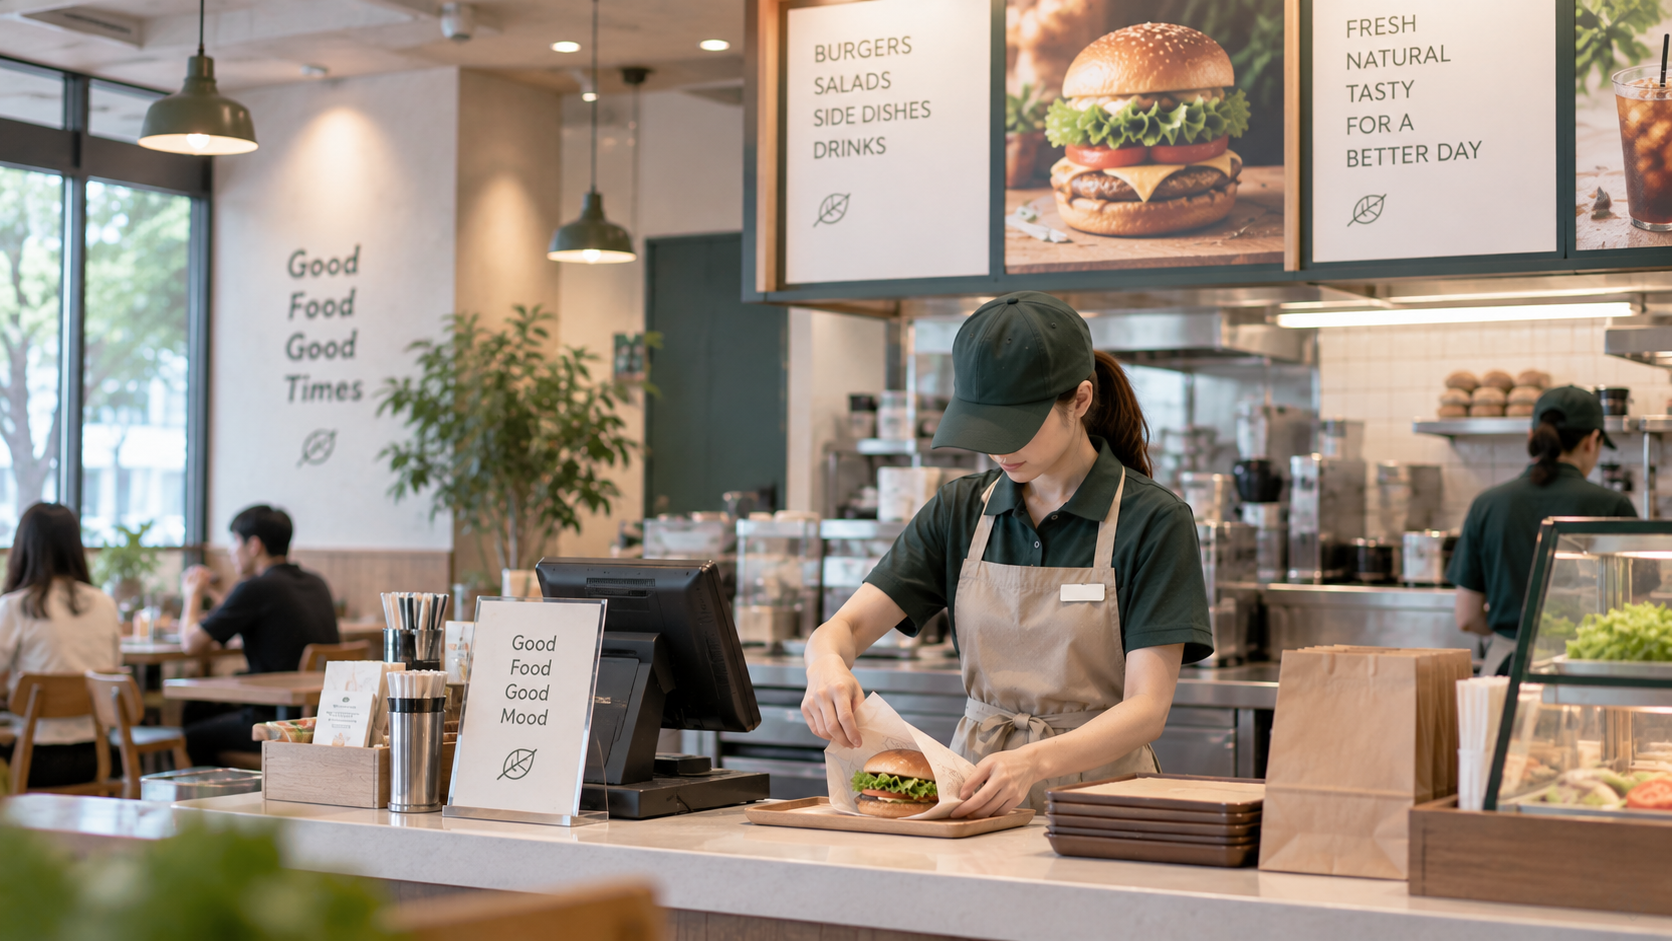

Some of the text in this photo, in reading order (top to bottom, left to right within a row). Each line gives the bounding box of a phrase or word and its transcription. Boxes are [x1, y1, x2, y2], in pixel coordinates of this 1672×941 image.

[1347, 14, 1416, 38] FRESH
[815, 36, 912, 63] BURGERS
[1347, 45, 1451, 70] NATURAL
[814, 71, 891, 95] SALADS
[1346, 80, 1414, 102] TASTY
[814, 100, 931, 127] SIDE DISHES
[1347, 113, 1415, 135] FOR A
[814, 137, 886, 159] DRINKS
[1347, 141, 1482, 167] BETTER DAY
[287, 244, 361, 279] Good
[289, 286, 356, 319] Food
[286, 329, 358, 361] Good
[285, 374, 363, 402] Times
[512, 635, 557, 652] Good
[511, 659, 552, 676] Food
[506, 683, 550, 701] Good
[501, 708, 549, 725] Mood
